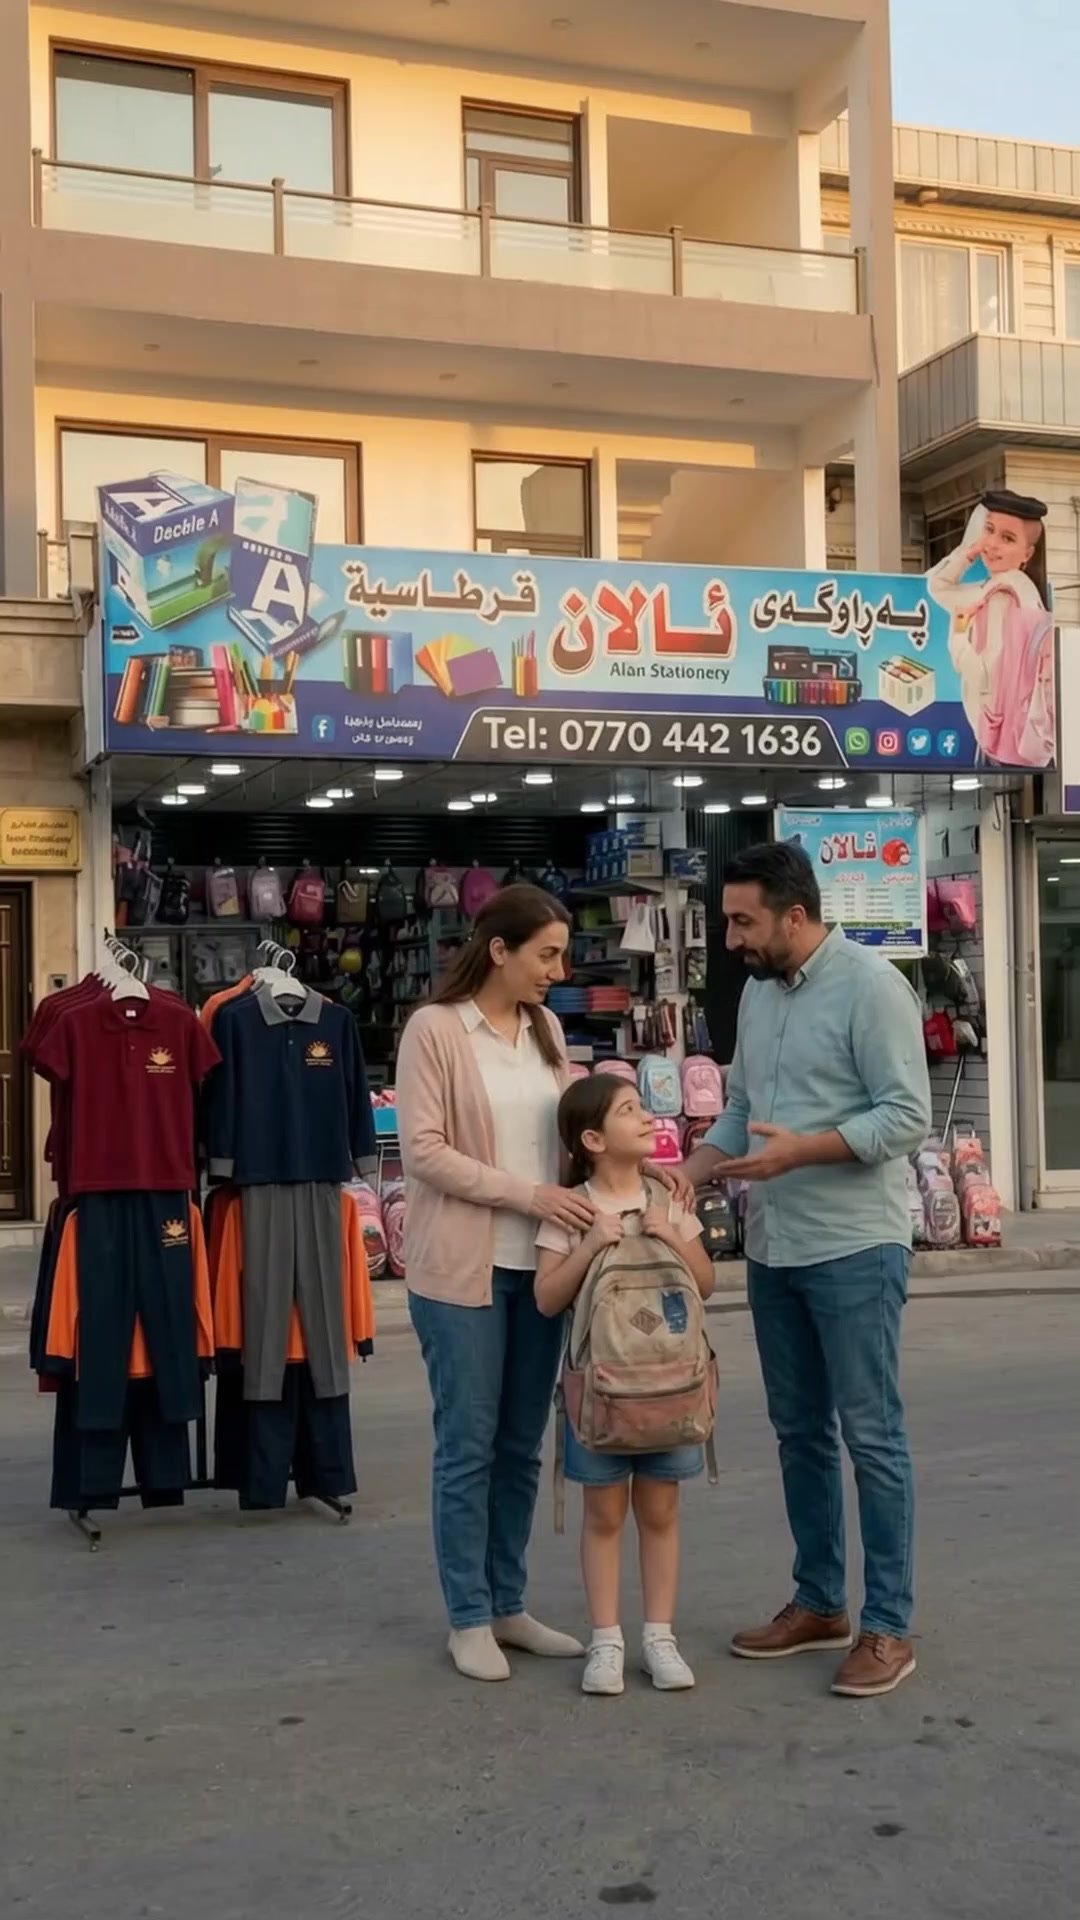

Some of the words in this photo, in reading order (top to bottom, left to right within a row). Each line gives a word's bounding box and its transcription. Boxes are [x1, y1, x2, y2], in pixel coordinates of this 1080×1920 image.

[208, 507, 219, 528] A
[345, 563, 537, 622] قرطاسية
[551, 582, 734, 674] ئالان
[609, 661, 646, 678] Alan
[650, 663, 731, 684] Stationery
[482, 716, 548, 750] Tel:
[559, 719, 651, 753] 0770
[662, 722, 730, 754] 442
[740, 723, 822, 757] 1636
